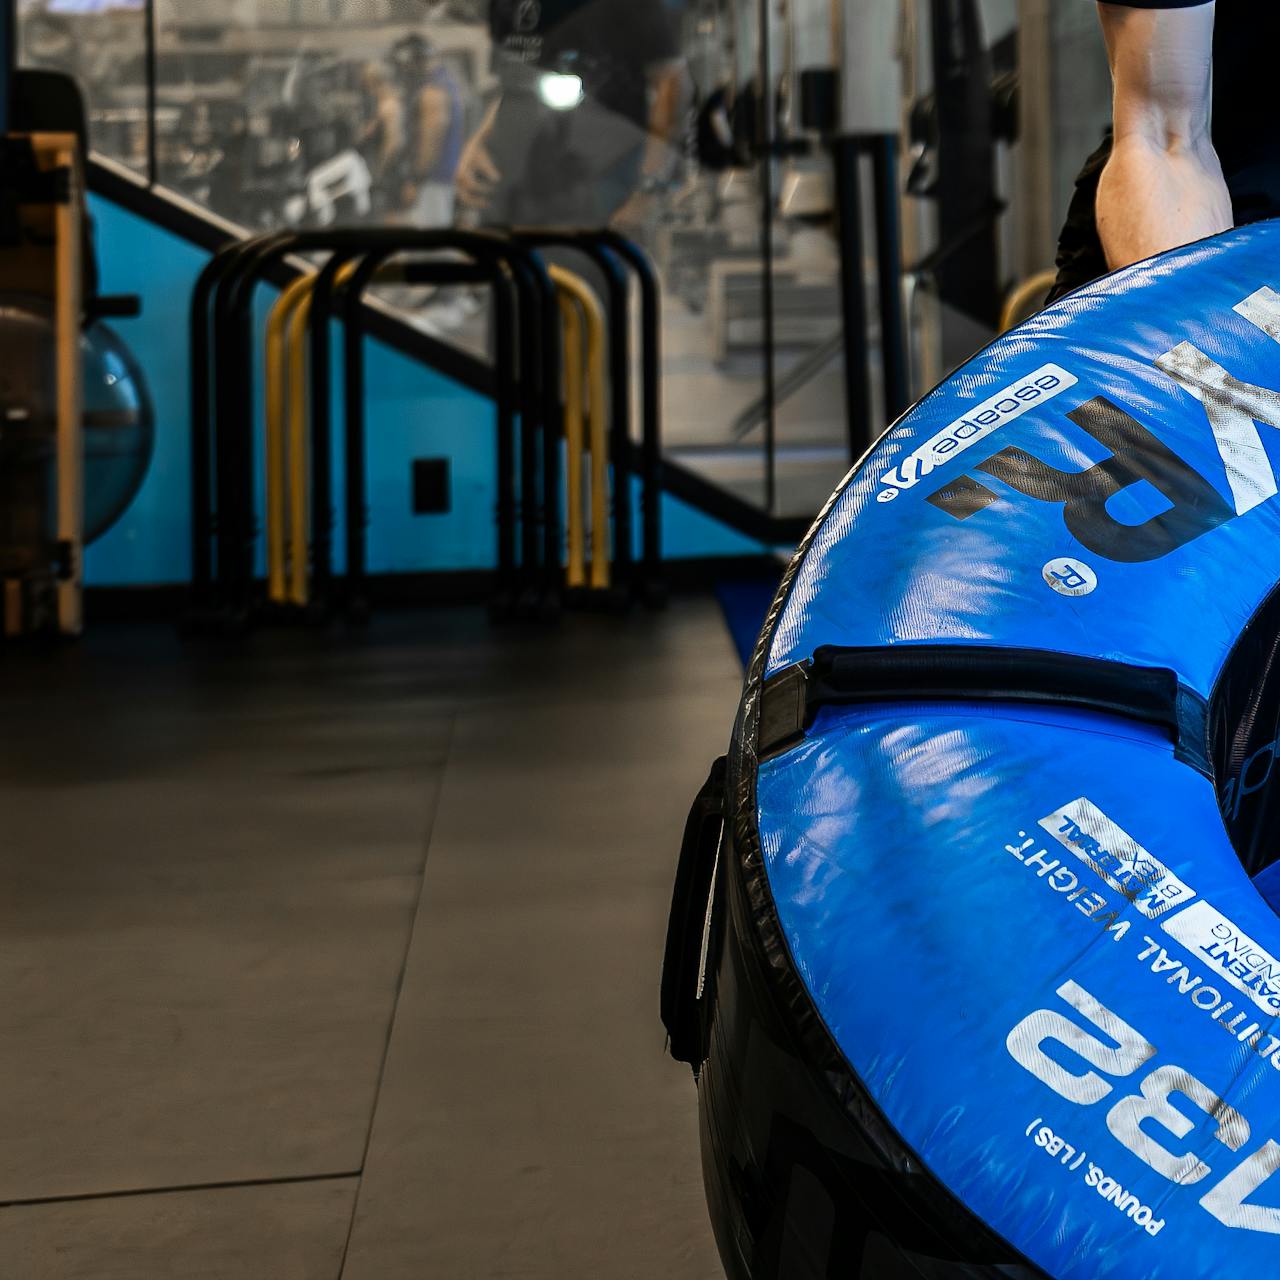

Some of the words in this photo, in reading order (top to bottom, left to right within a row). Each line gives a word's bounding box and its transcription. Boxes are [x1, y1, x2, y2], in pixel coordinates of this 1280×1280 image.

[933, 375, 1060, 454] escape
[1005, 831, 1130, 942] WEIGHT.
[1084, 1162, 1166, 1236] POUNDS.
